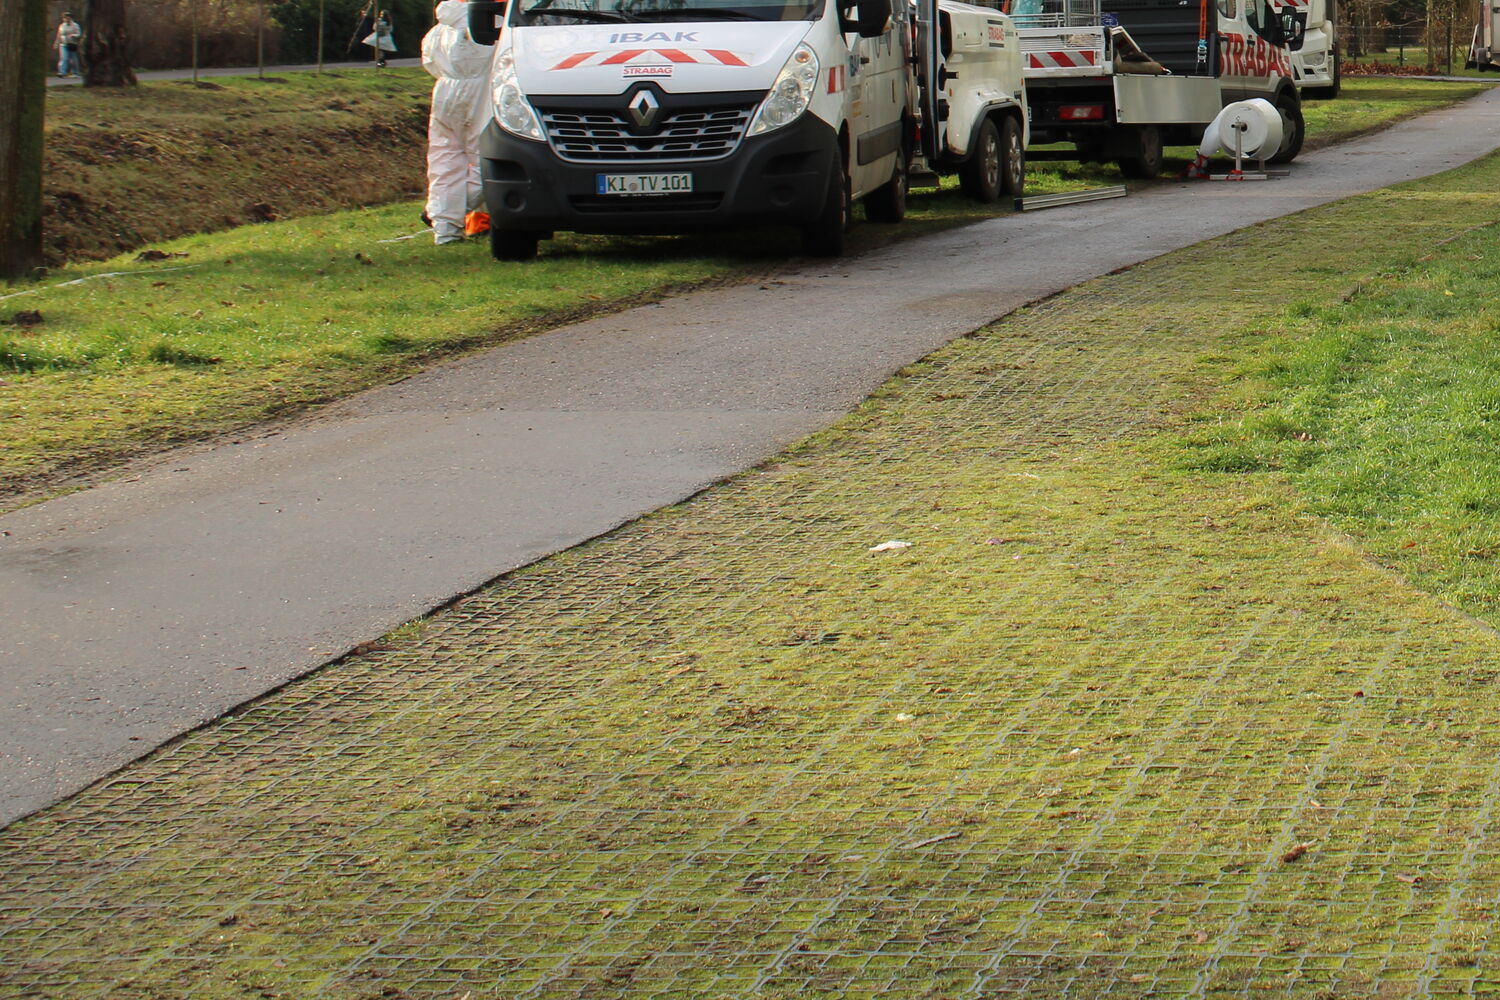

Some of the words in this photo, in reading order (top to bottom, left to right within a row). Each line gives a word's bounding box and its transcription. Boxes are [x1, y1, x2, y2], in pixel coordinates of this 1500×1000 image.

[609, 32, 699, 44] IBAK
[623, 67, 673, 75] STRABAG
[607, 176, 627, 192] KI
[638, 175, 659, 191] TV
[661, 175, 691, 191] 101
